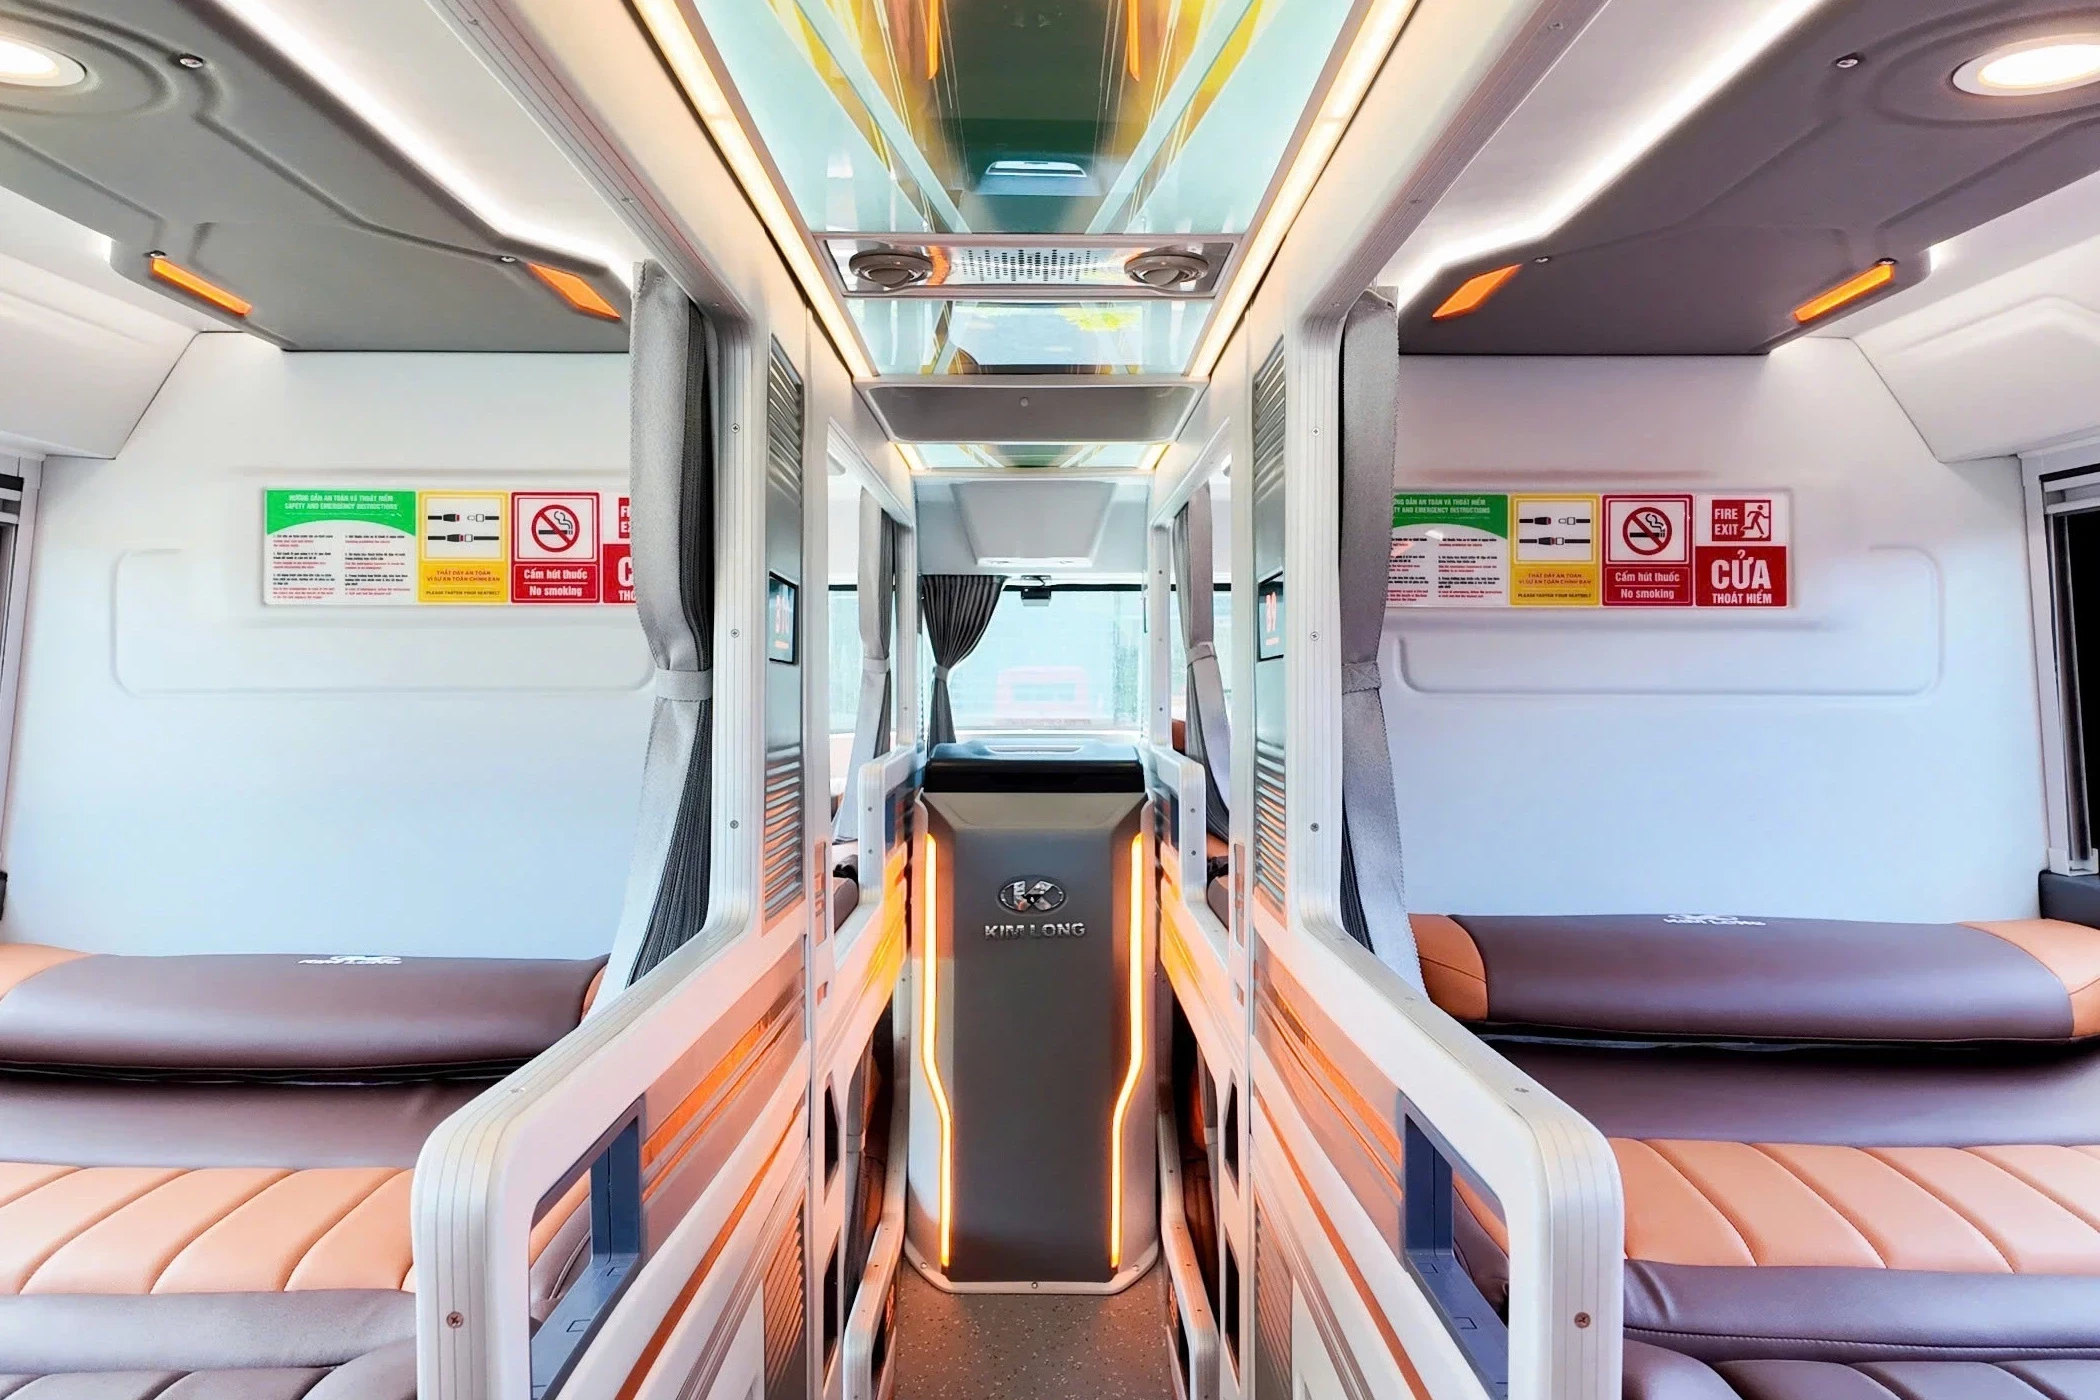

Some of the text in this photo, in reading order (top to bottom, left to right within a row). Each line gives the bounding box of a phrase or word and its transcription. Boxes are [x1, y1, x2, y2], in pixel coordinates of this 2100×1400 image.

[1714, 508, 1738, 520] FIRE
[1714, 524, 1739, 535] EXIT
[524, 568, 588, 579] Cấm hút thuốc
[1615, 570, 1680, 582] Cấm hút thuốc
[1711, 550, 1772, 590] CỬA
[529, 586, 582, 598] No smoking
[618, 590, 636, 601] THO
[1620, 589, 1674, 600] No smoking
[1712, 588, 1772, 604] THOÁT HIỂM
[984, 922, 1086, 938] KIM LONG
